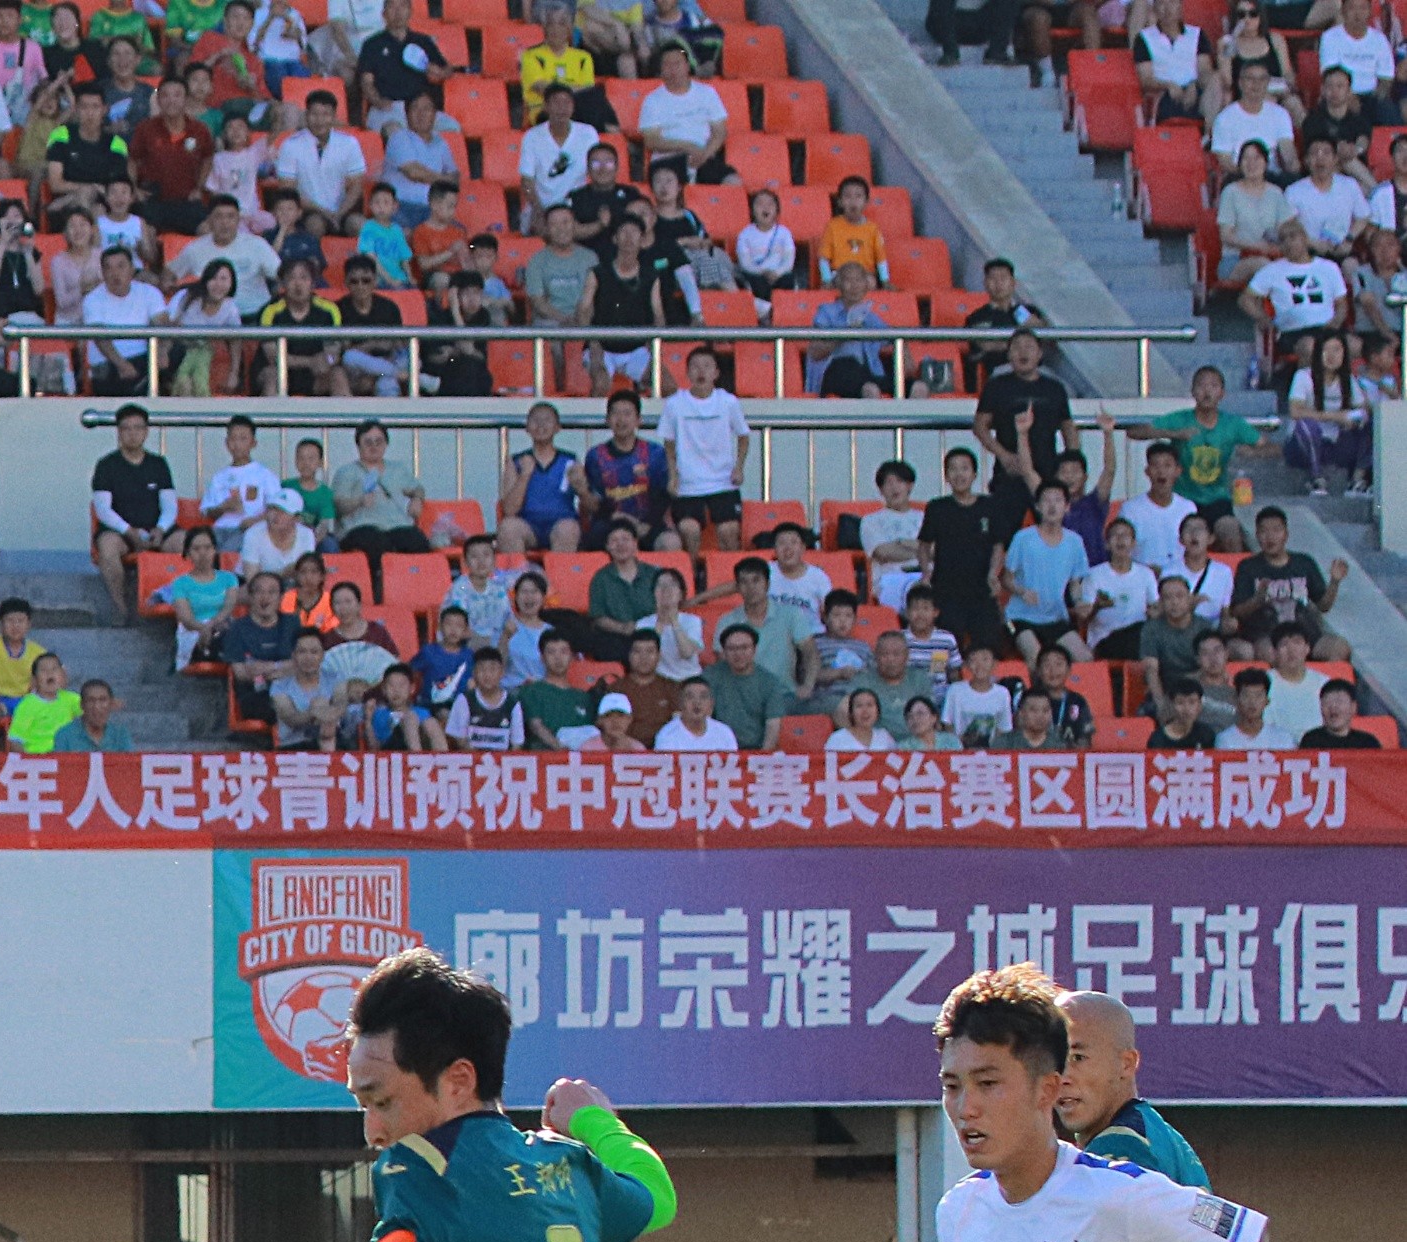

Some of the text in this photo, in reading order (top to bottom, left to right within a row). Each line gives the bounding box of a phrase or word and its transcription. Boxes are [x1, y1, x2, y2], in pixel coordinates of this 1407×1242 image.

[268, 875, 392, 922] LANGFANG
[244, 929, 298, 968] CITY
[304, 924, 335, 955] OF
